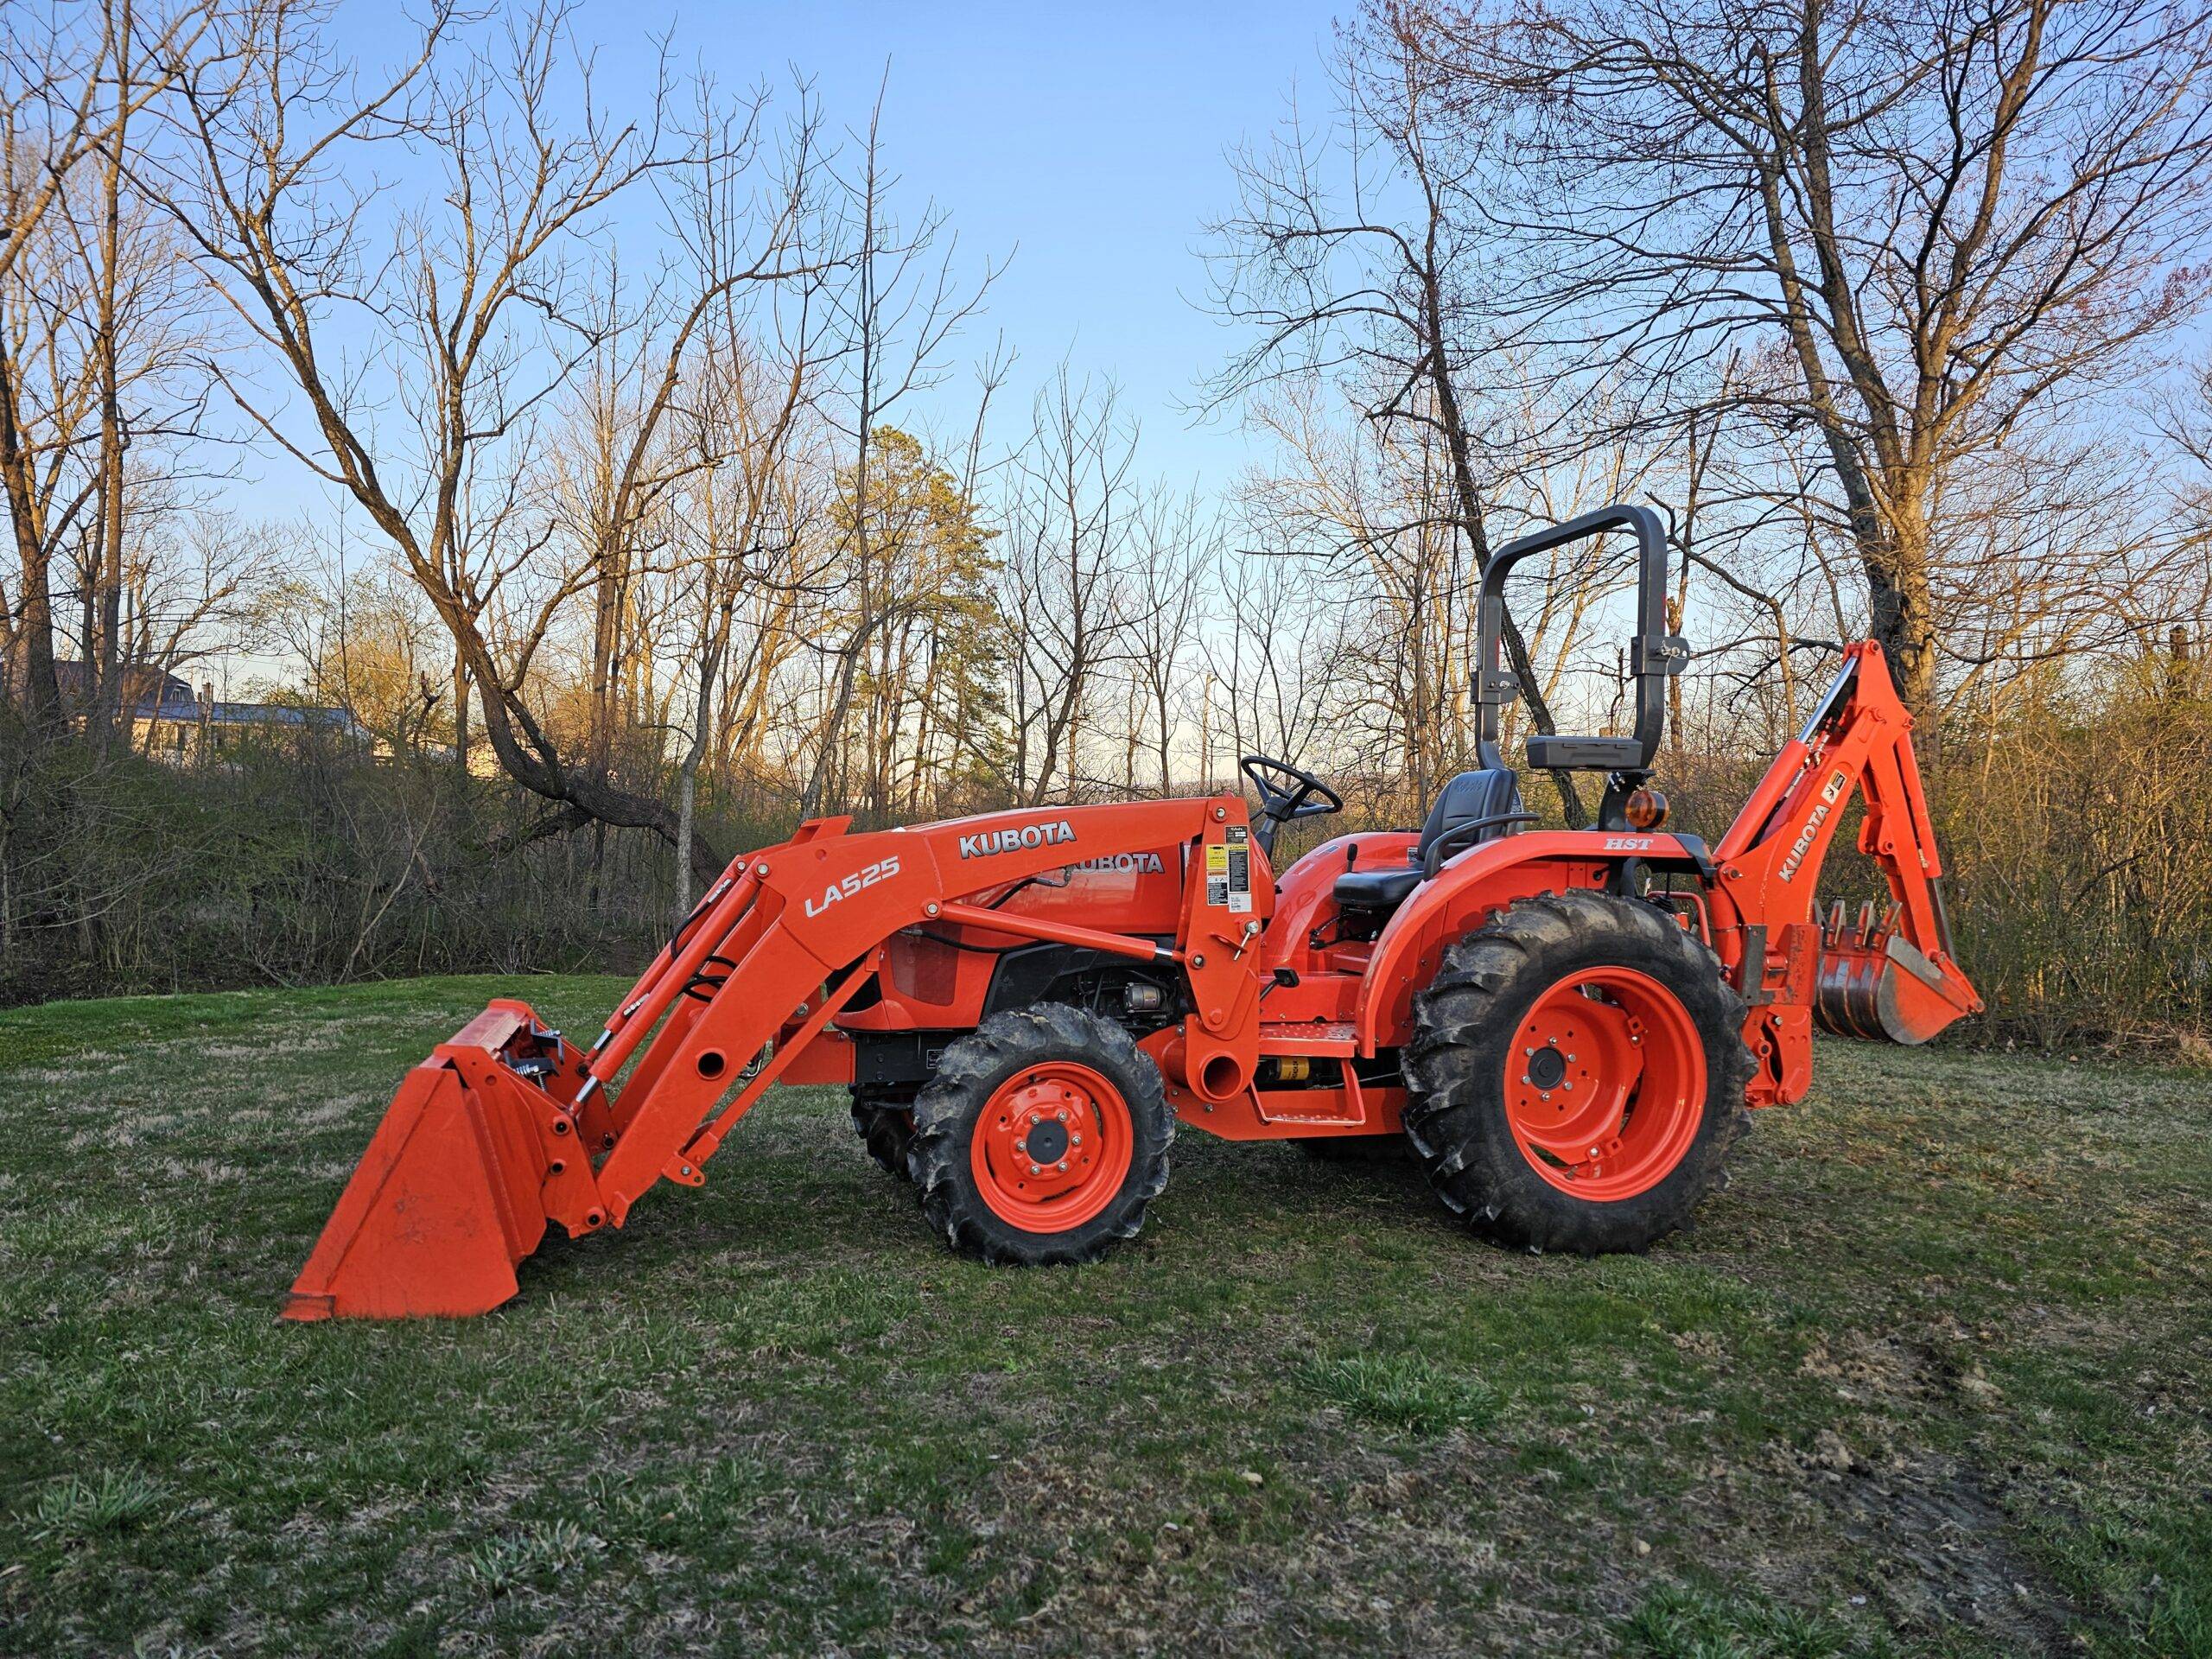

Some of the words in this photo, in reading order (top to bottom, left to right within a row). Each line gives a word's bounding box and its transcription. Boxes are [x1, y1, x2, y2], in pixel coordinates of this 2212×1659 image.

[959, 820, 1077, 860] KUBOTA
[1603, 838, 1654, 850] HST
[1778, 804, 1831, 883] KUBOTA
[804, 855, 900, 918] LA525
